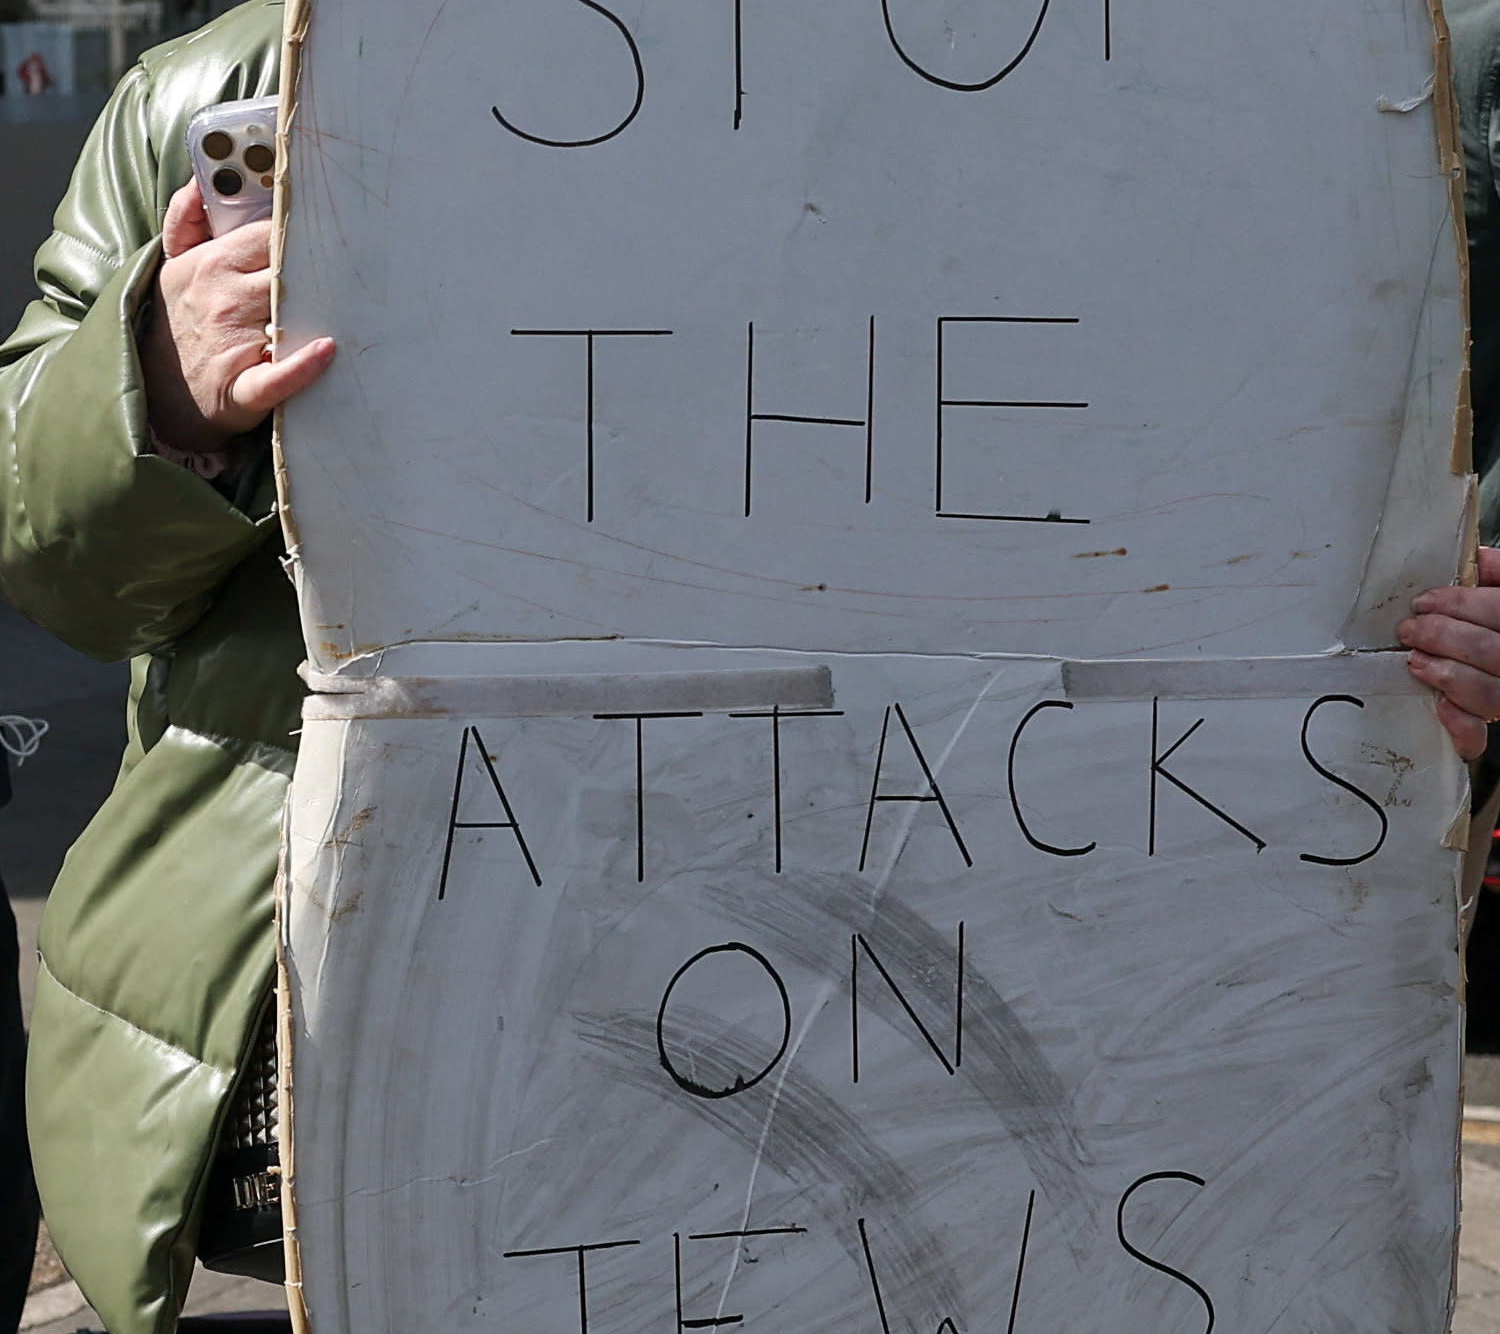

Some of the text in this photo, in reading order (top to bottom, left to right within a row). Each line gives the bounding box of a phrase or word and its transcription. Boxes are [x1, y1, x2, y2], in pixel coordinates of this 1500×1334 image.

[511, 314, 1090, 524] THE
[439, 693, 1388, 900] ATTACKS
[656, 920, 965, 1099] ON
